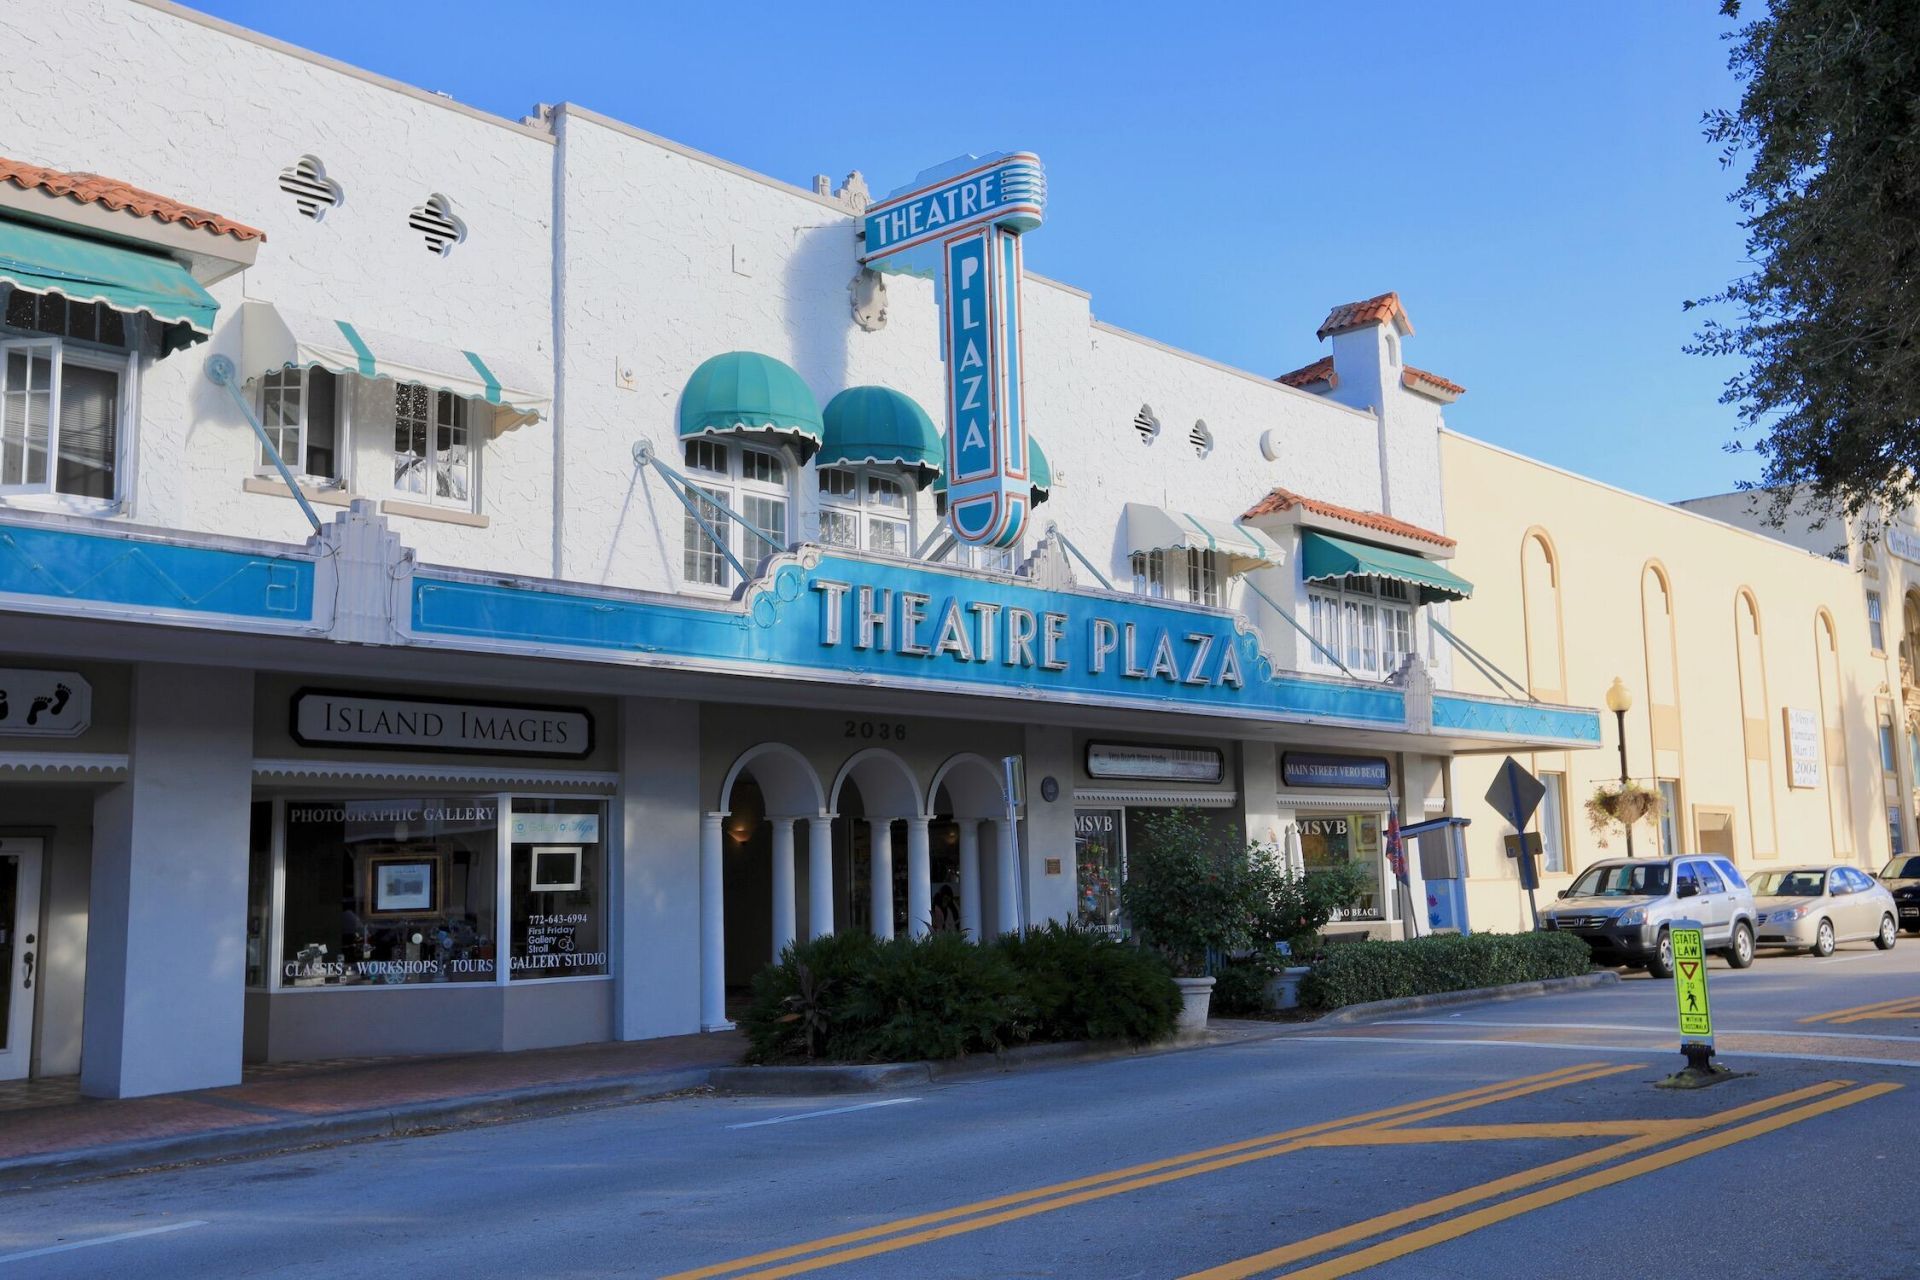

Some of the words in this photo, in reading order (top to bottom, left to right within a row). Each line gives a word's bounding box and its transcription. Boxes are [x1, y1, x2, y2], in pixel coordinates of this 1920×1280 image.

[875, 174, 996, 246] THEATRE
[959, 256, 986, 453] PLAZA
[811, 578, 1070, 670] THEATRE
[1088, 616, 1244, 689] PLAZA
[844, 720, 906, 741] 2036
[1287, 763, 1308, 775] MAIN
[1309, 764, 1338, 777] STREET
[1339, 766, 1360, 778] VERO
[1361, 767, 1385, 779] BEACH
[291, 807, 418, 823] PHOTOGRAPHIC
[423, 807, 496, 821] GALLERY
[1074, 815, 1113, 832] MSVB
[1296, 820, 1347, 835] MSVB
[528, 913, 587, 924] 772-643-6994
[1352, 907, 1379, 917] BEACH
[528, 927, 545, 935] First
[547, 926, 574, 935] Friday
[528, 935, 557, 945] Gallery
[1674, 933, 1698, 945] STATE
[528, 944, 549, 953] Stroll
[1677, 946, 1698, 956] LAW
[284, 962, 343, 977] CLASSES
[356, 959, 438, 975] WORKSHOPS
[451, 958, 494, 973] TOURS
[510, 953, 561, 970] GALLERY
[564, 952, 607, 967] STUDIO
